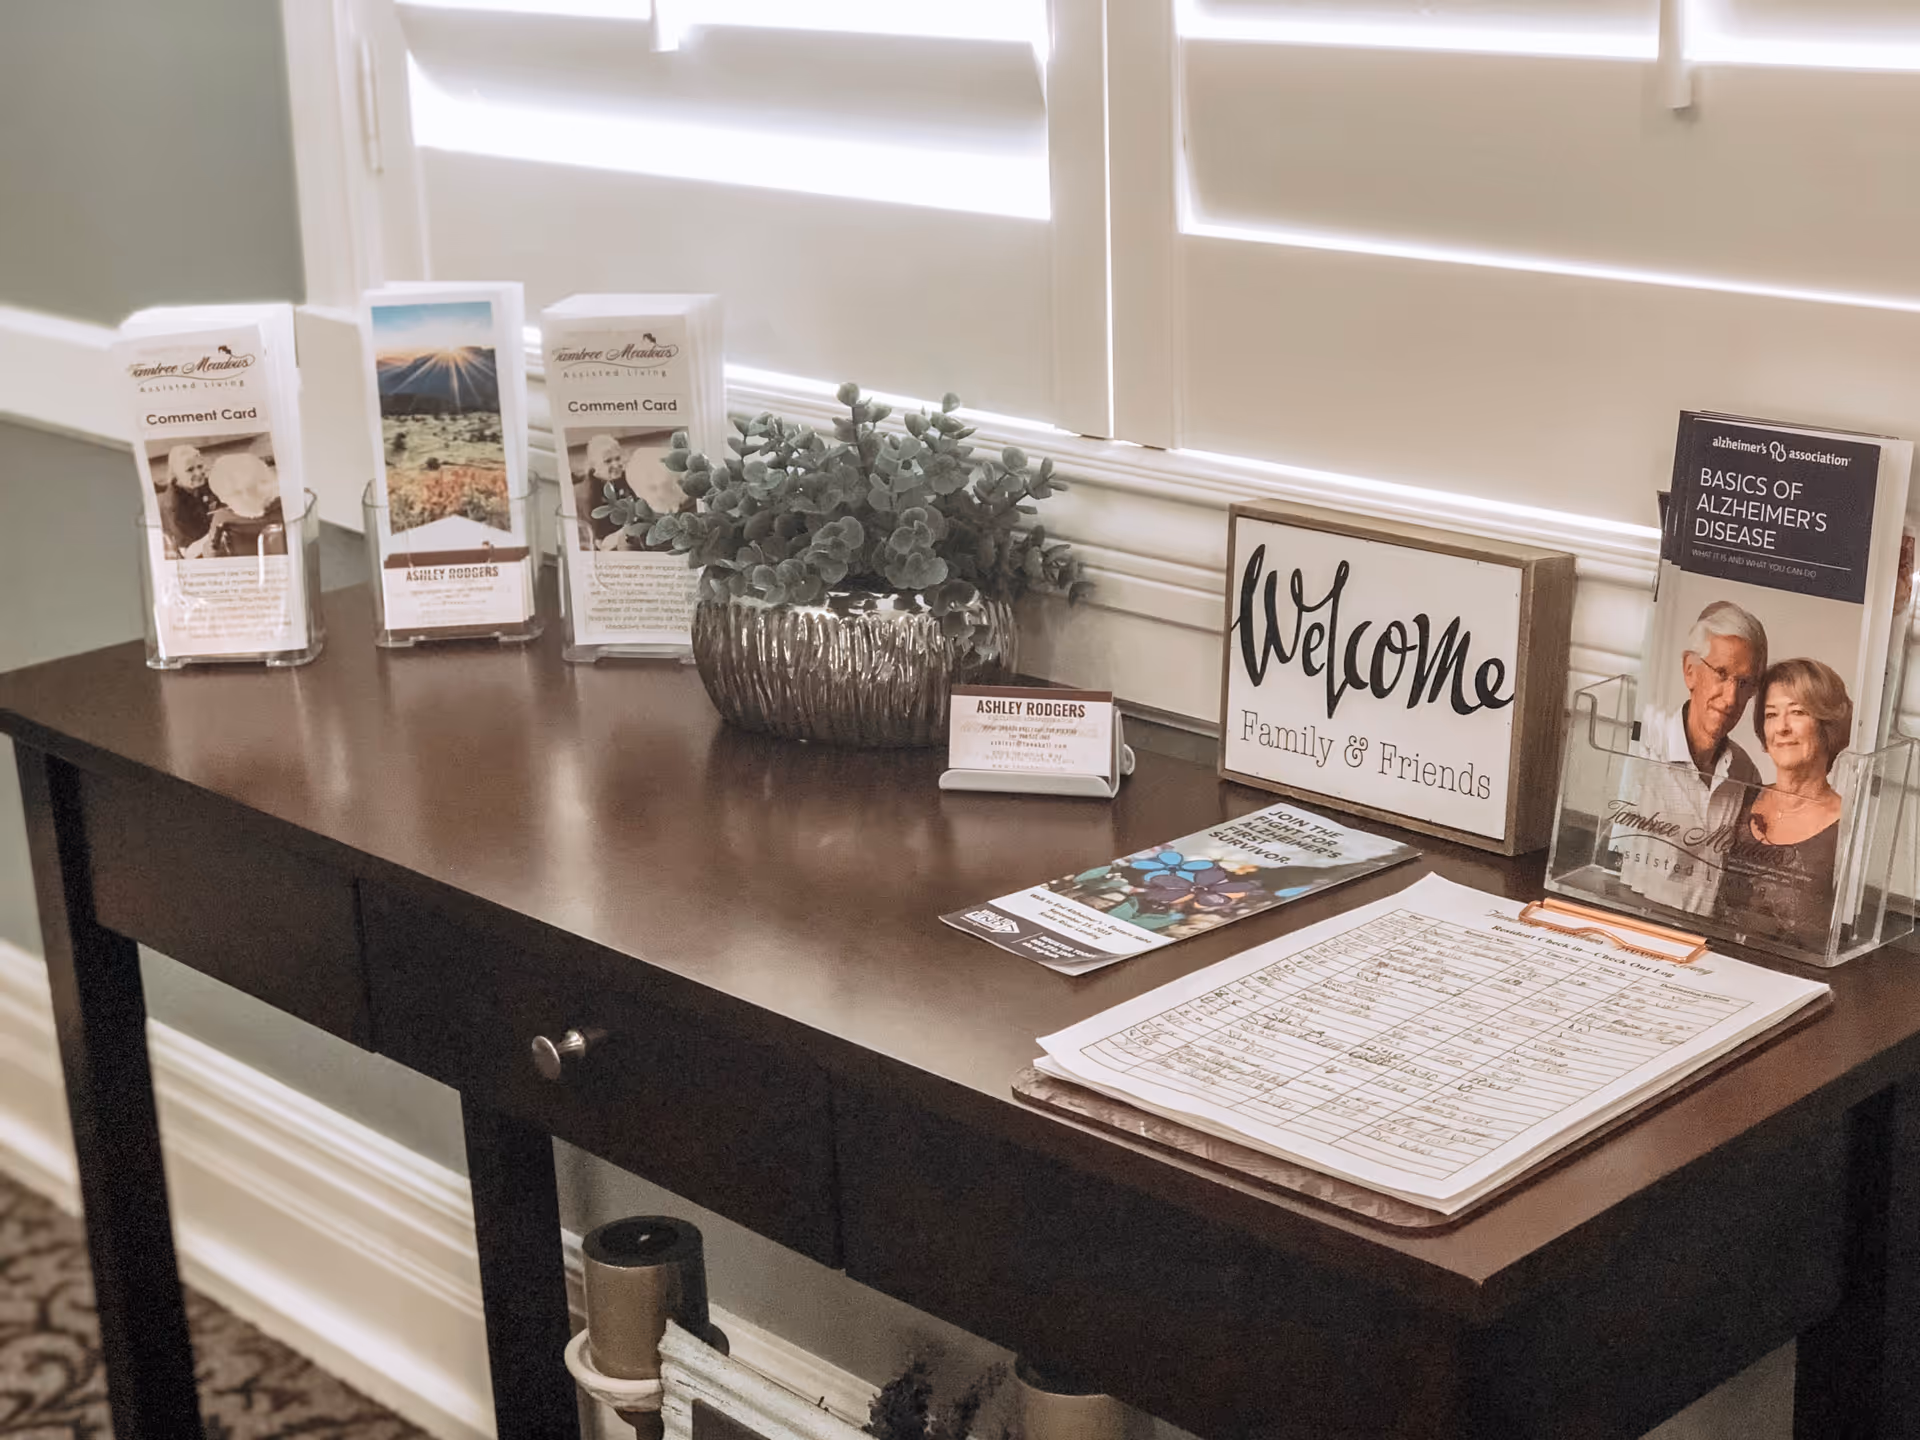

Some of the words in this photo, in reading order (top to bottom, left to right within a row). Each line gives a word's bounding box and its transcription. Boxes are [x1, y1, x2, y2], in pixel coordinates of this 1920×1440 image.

[181, 353, 256, 374] Meadows
[604, 343, 679, 361] Meadows
[139, 382, 196, 393] Assisted
[203, 379, 245, 389] Living
[563, 369, 620, 379] Assisted
[626, 368, 667, 378] Living
[145, 409, 218, 425] Comment
[220, 406, 258, 421] Card
[567, 399, 639, 413] Comment
[642, 398, 678, 412] Card
[1712, 435, 1767, 455] alzheimer's
[1788, 448, 1849, 467] association
[1699, 467, 1768, 496] BASICS
[1773, 480, 1803, 500] OF
[1696, 492, 1827, 532] ALZHEIMER'S
[1694, 517, 1777, 550] DISEASE
[406, 568, 446, 582] ASHLEY
[448, 565, 499, 580] RODGERS
[1691, 549, 1712, 558] WHAT
[1720, 553, 1727, 562] IS
[1728, 555, 1745, 565] AND
[1745, 560, 1767, 569] WHAT
[1769, 563, 1786, 573] YOU
[1786, 566, 1803, 576] CAN
[1803, 569, 1817, 578] DO
[1231, 543, 1515, 719] Welcome
[976, 700, 1022, 715] ASHLEY
[1026, 702, 1085, 718] RODGERS
[1240, 710, 1334, 768] Family
[1344, 735, 1368, 768] &
[1378, 741, 1491, 800] Friends
[1224, 826, 1271, 845] FIRST
[1254, 815, 1305, 836] FIGHT
[1302, 834, 1338, 847] FOR
[1268, 811, 1309, 827] JOIN
[1309, 825, 1344, 839] THE
[1208, 831, 1291, 864] SURVIVOR.
[1239, 822, 1342, 859] ALZHEIMER'S
[1612, 845, 1695, 877] Assisted
[1491, 924, 1536, 940] Resident
[1537, 936, 1570, 950] Check
[1571, 945, 1583, 953] in
[1594, 951, 1627, 966] Check
[1629, 961, 1652, 972] Out
[1652, 967, 1677, 979] Log
[1598, 966, 1617, 975] Time
